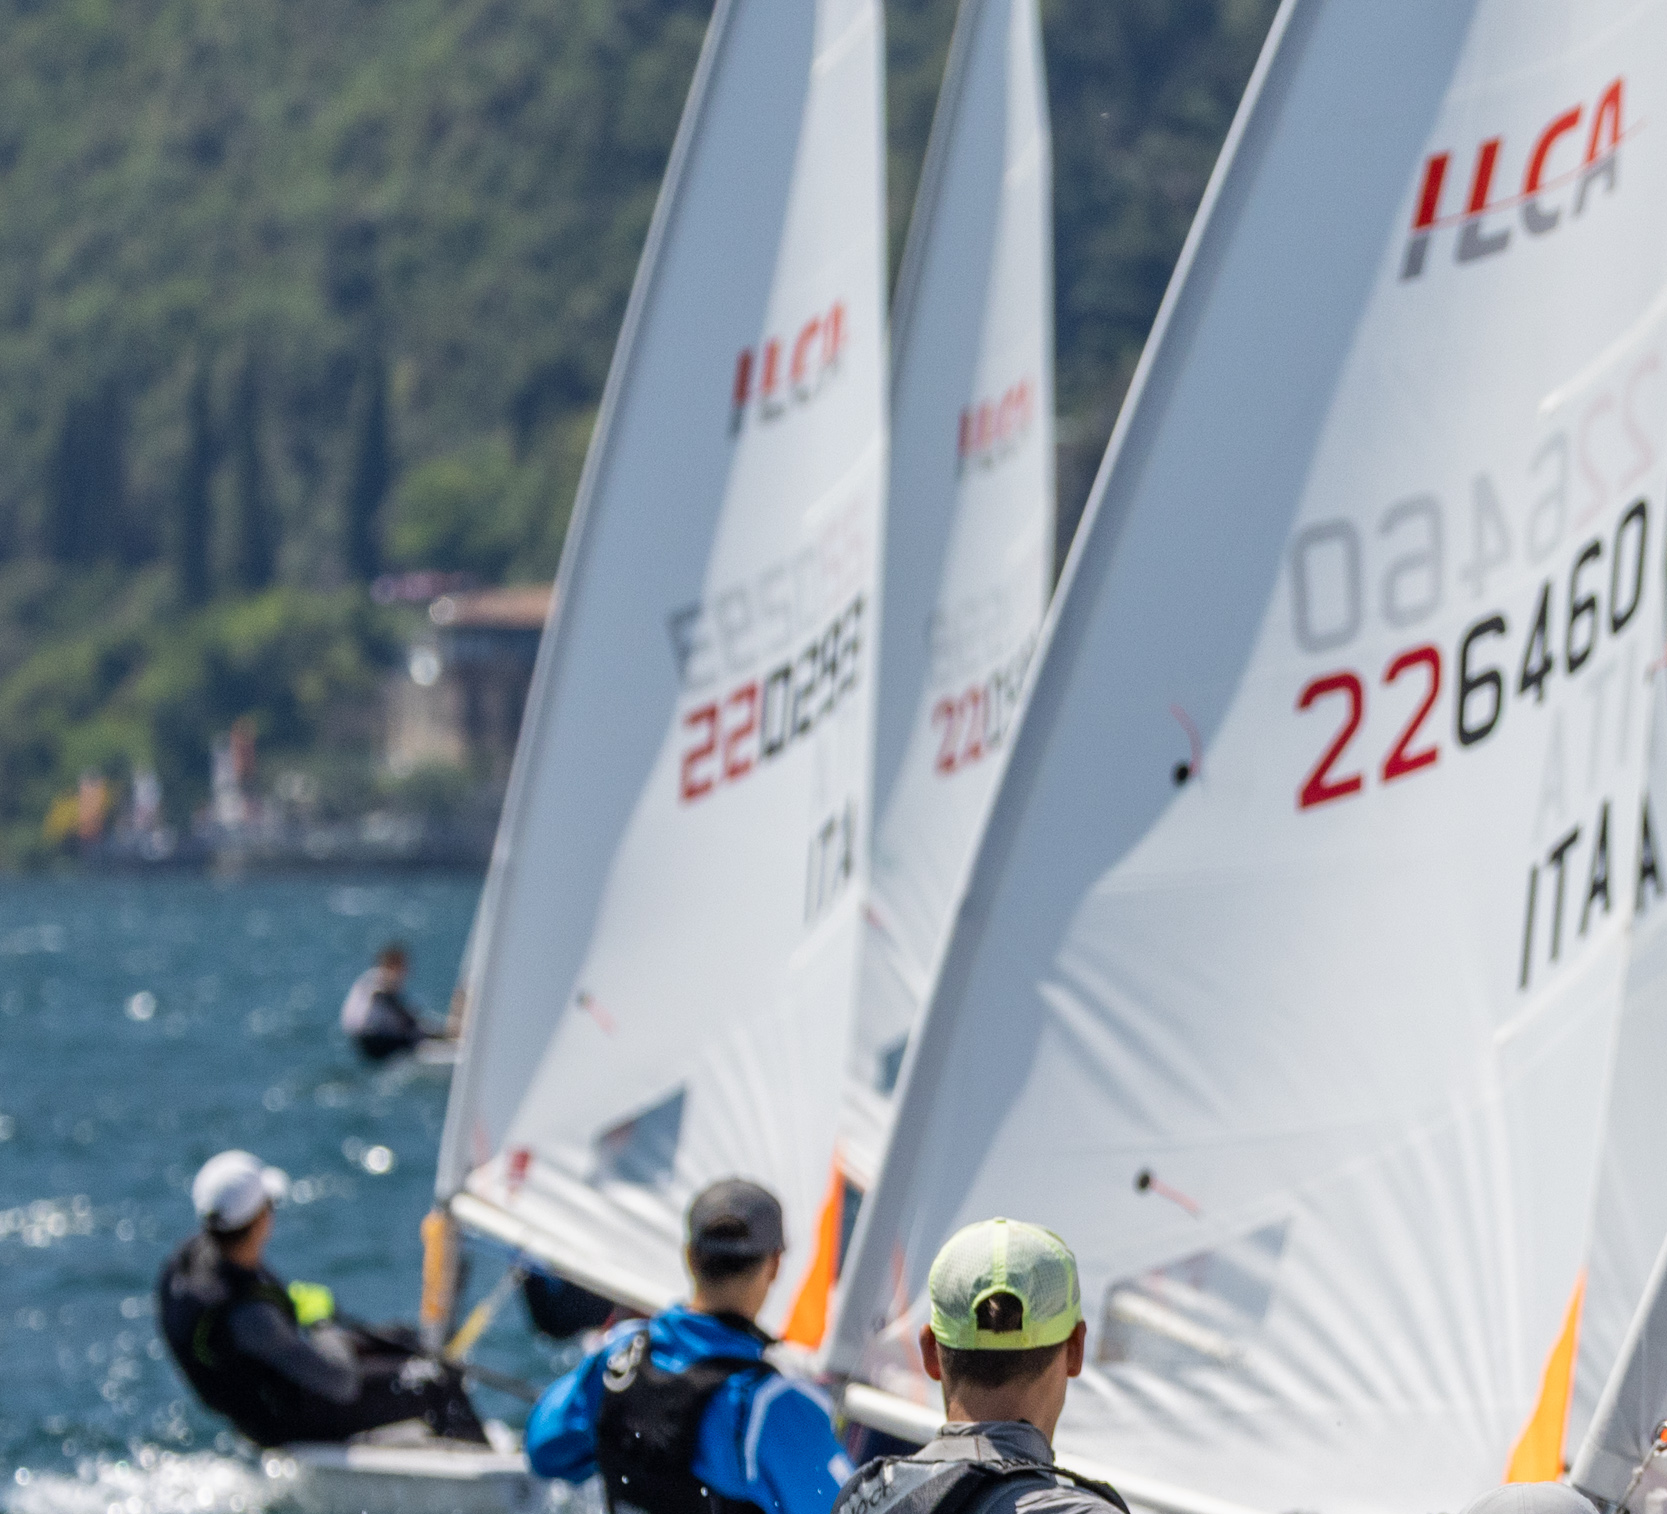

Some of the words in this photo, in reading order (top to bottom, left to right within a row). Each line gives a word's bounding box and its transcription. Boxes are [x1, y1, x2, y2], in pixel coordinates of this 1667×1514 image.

[1400, 75, 1626, 282] ILCA
[730, 300, 847, 437] ILCA
[1295, 498, 1648, 812] 226460
[1517, 798, 1613, 992] ITA
